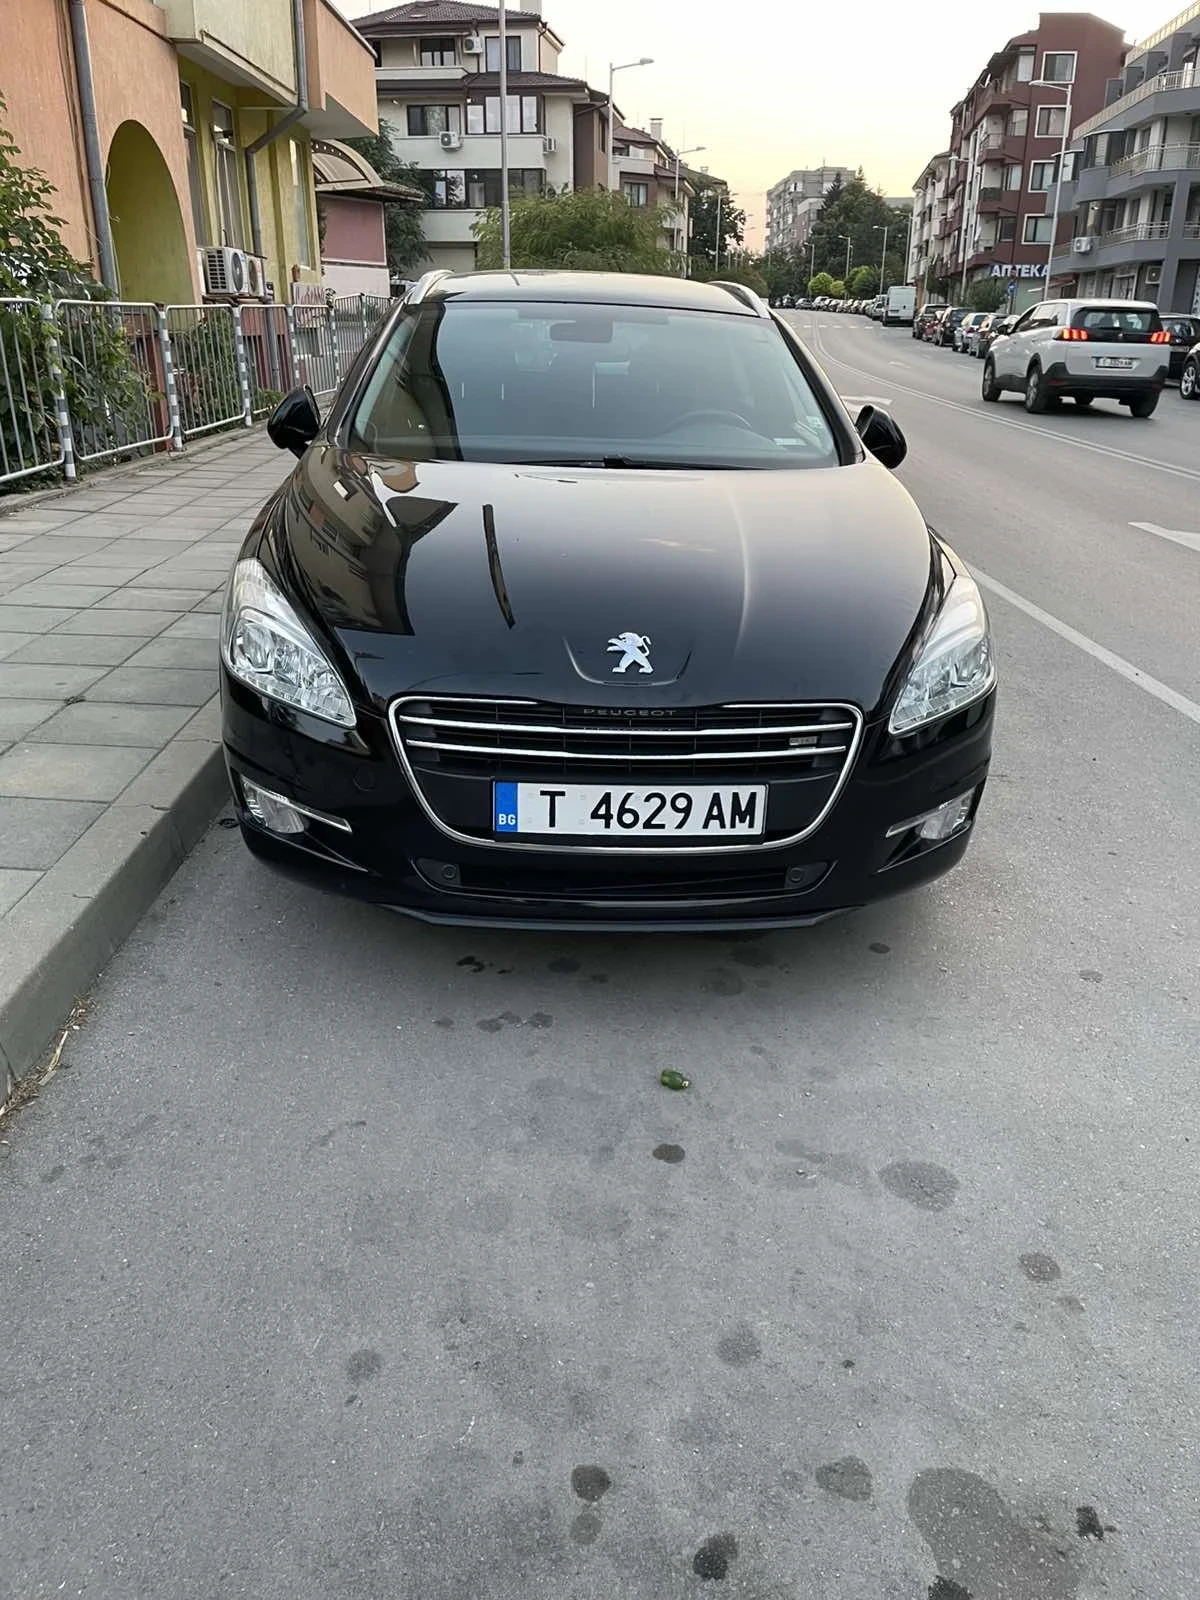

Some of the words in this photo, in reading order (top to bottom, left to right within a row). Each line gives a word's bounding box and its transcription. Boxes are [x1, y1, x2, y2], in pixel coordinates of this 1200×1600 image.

[991, 264, 1050, 277] АПТЕКА
[583, 708, 677, 716] PEUGEOT
[539, 790, 566, 828] T
[590, 791, 694, 829] 4629
[702, 791, 757, 829] AM
[498, 813, 516, 826] BG
